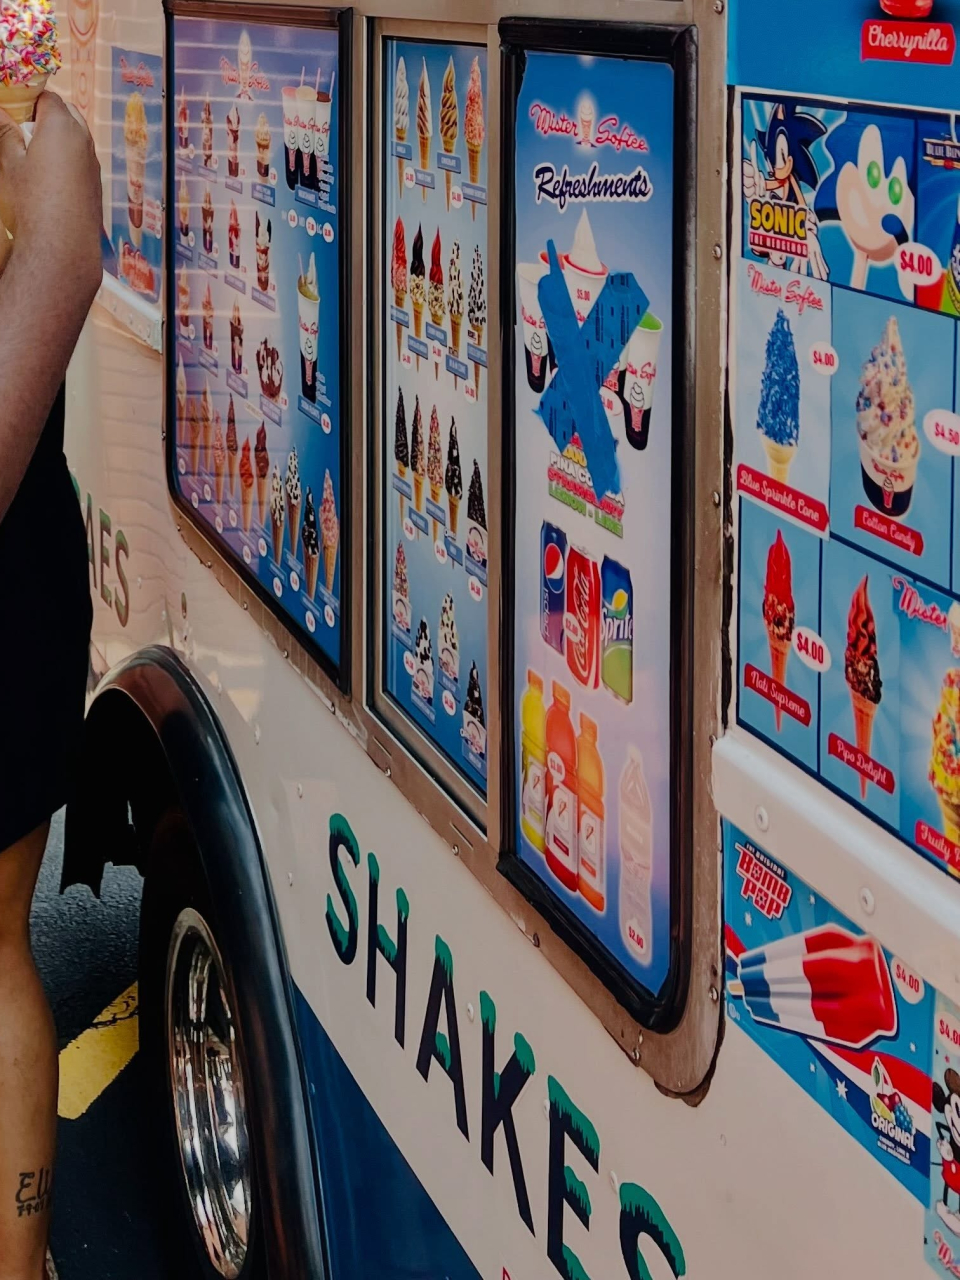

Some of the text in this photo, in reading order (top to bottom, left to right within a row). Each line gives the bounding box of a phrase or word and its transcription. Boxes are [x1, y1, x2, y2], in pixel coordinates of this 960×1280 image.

[868, 24, 949, 57] Cherrynilla
[529, 103, 649, 152] Mister Softee
[534, 163, 651, 211] Refreshments
[750, 200, 807, 239] SONIC
[900, 251, 933, 276] $4.00
[748, 264, 823, 316] Mister Softee
[813, 353, 834, 368] $4.00
[739, 470, 820, 522] Blue Sprinkle Cone
[862, 511, 916, 554] Cotton Candy
[891, 575, 949, 633] Mister
[796, 632, 825, 664] $4.00
[770, 683, 806, 719] Supreme
[856, 751, 887, 785] Delight
[920, 824, 951, 862] Fruity
[737, 845, 791, 906] BOMB
[742, 877, 783, 918] POP
[628, 925, 644, 949] $2.00
[895, 963, 920, 994] $4.00
[871, 1112, 916, 1152] ORIGINAL
